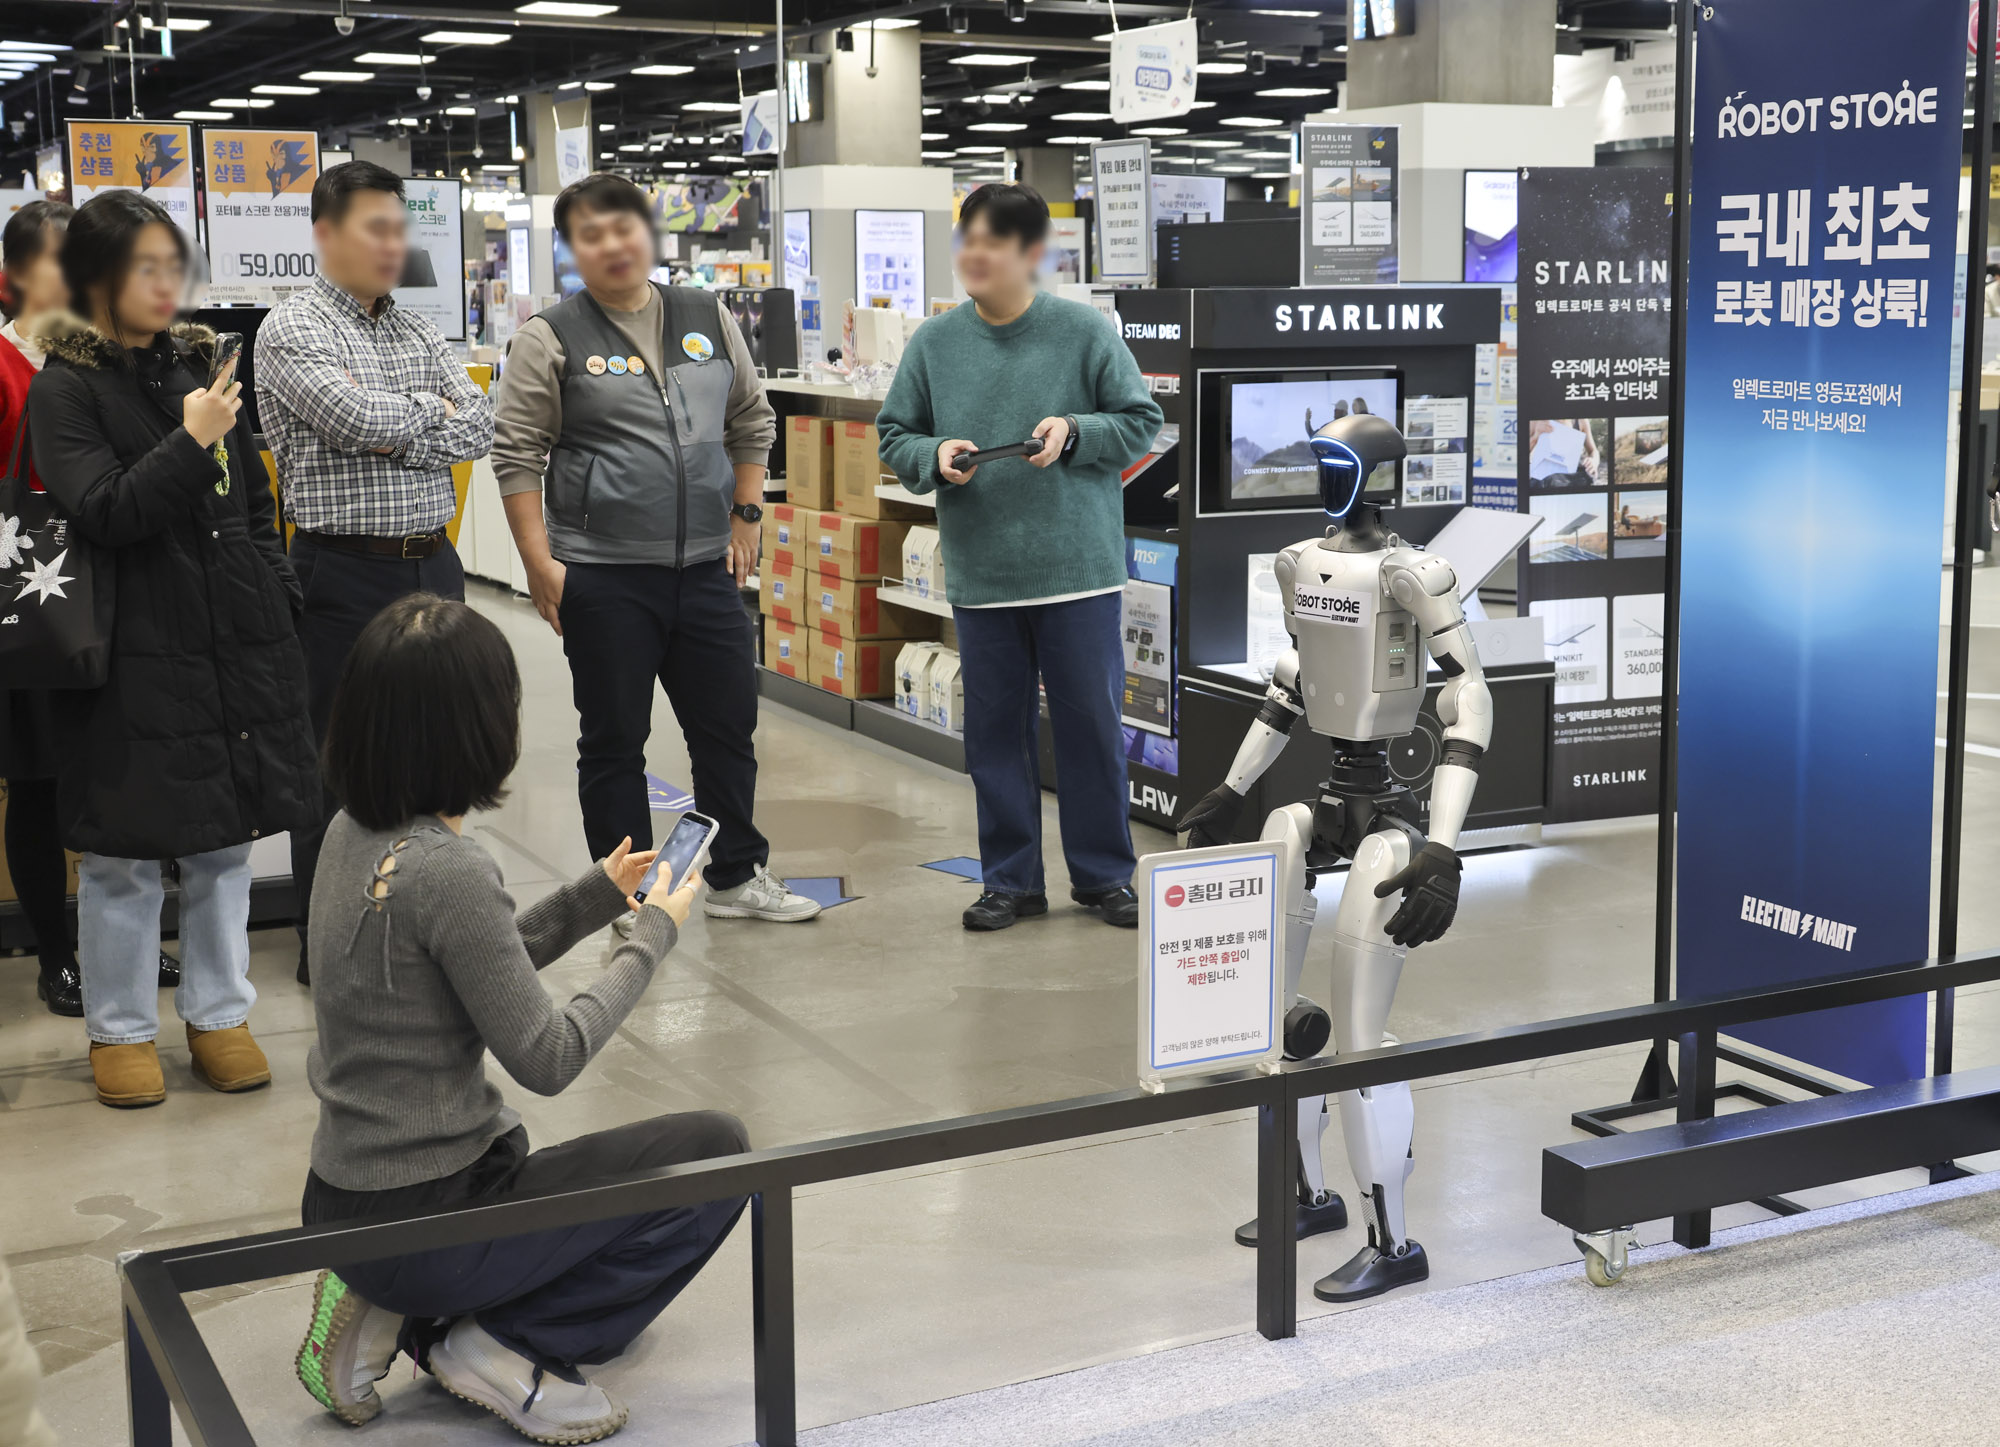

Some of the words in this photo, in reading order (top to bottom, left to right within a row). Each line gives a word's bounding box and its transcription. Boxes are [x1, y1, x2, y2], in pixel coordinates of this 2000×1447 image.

[1718, 96, 1823, 138] ROBOT
[1829, 80, 1938, 130] STORE
[79, 132, 112, 153] 추천
[1311, 134, 1352, 142] STARLINK
[213, 140, 244, 161] 추천
[79, 156, 114, 177] 상품
[214, 164, 246, 184] 상품
[1100, 161, 1112, 175] 게임
[1115, 160, 1127, 173] 이용
[1129, 158, 1142, 172] 안내
[215, 204, 242, 217] 포터블
[245, 205, 271, 217] 스크린
[273, 204, 311, 217] 전용가방
[407, 198, 436, 212] eat
[419, 214, 447, 225] 스크린
[1717, 189, 1811, 267] 국내
[1824, 182, 1931, 266] 최초
[239, 253, 315, 278] 59,000
[1535, 260, 1668, 284] STARLIN
[1535, 299, 1604, 313] 일렉트로마트
[1609, 298, 1631, 312] 공식
[1636, 298, 1658, 312] 단독
[1714, 281, 1773, 327] 로봇
[1781, 279, 1845, 327] 매장
[1851, 279, 1929, 328] 상륙!
[1276, 304, 1444, 331] STARLINK
[1125, 323, 1157, 339] STEAM
[1550, 358, 1610, 379] 우주에서
[1613, 357, 1670, 377] 쏘아주는
[1565, 382, 1610, 401] 초고속
[1613, 380, 1658, 401] 인터넷
[1732, 378, 1812, 402] 일렉트로마트
[1815, 381, 1902, 407] 영등포점에서
[1762, 408, 1789, 431] 지금
[1792, 409, 1866, 434] 만나보세요!
[1243, 467, 1269, 475] CONNECT
[1270, 466, 1286, 474] FROM
[1134, 549, 1158, 565] msi
[1321, 597, 1360, 614] STORE
[1554, 653, 1584, 663] MINIKIT
[1627, 662, 1662, 675] 360,00
[1573, 769, 1647, 787] STARLINK
[1128, 780, 1178, 817] LAW
[1188, 882, 1223, 904] 출입
[1229, 877, 1263, 899] 금지
[1741, 895, 1801, 936] ELECTRO
[1812, 916, 1857, 952] MART
[1160, 941, 1179, 955] 안전
[1182, 939, 1191, 952] 및
[1194, 936, 1213, 950] 제품
[1216, 931, 1245, 947] 보호를
[1247, 929, 1267, 942] 위해
[1177, 956, 1197, 970] 가드
[1199, 953, 1218, 968] 안쪽
[1221, 948, 1250, 965] 출입이
[1187, 968, 1239, 986] 제한됩니다.
[1161, 1042, 1189, 1053] 고객님의
[1190, 1040, 1204, 1049] 많은
[1205, 1037, 1219, 1047] 양해
[1220, 1030, 1263, 1044] 부탁드립니다.
